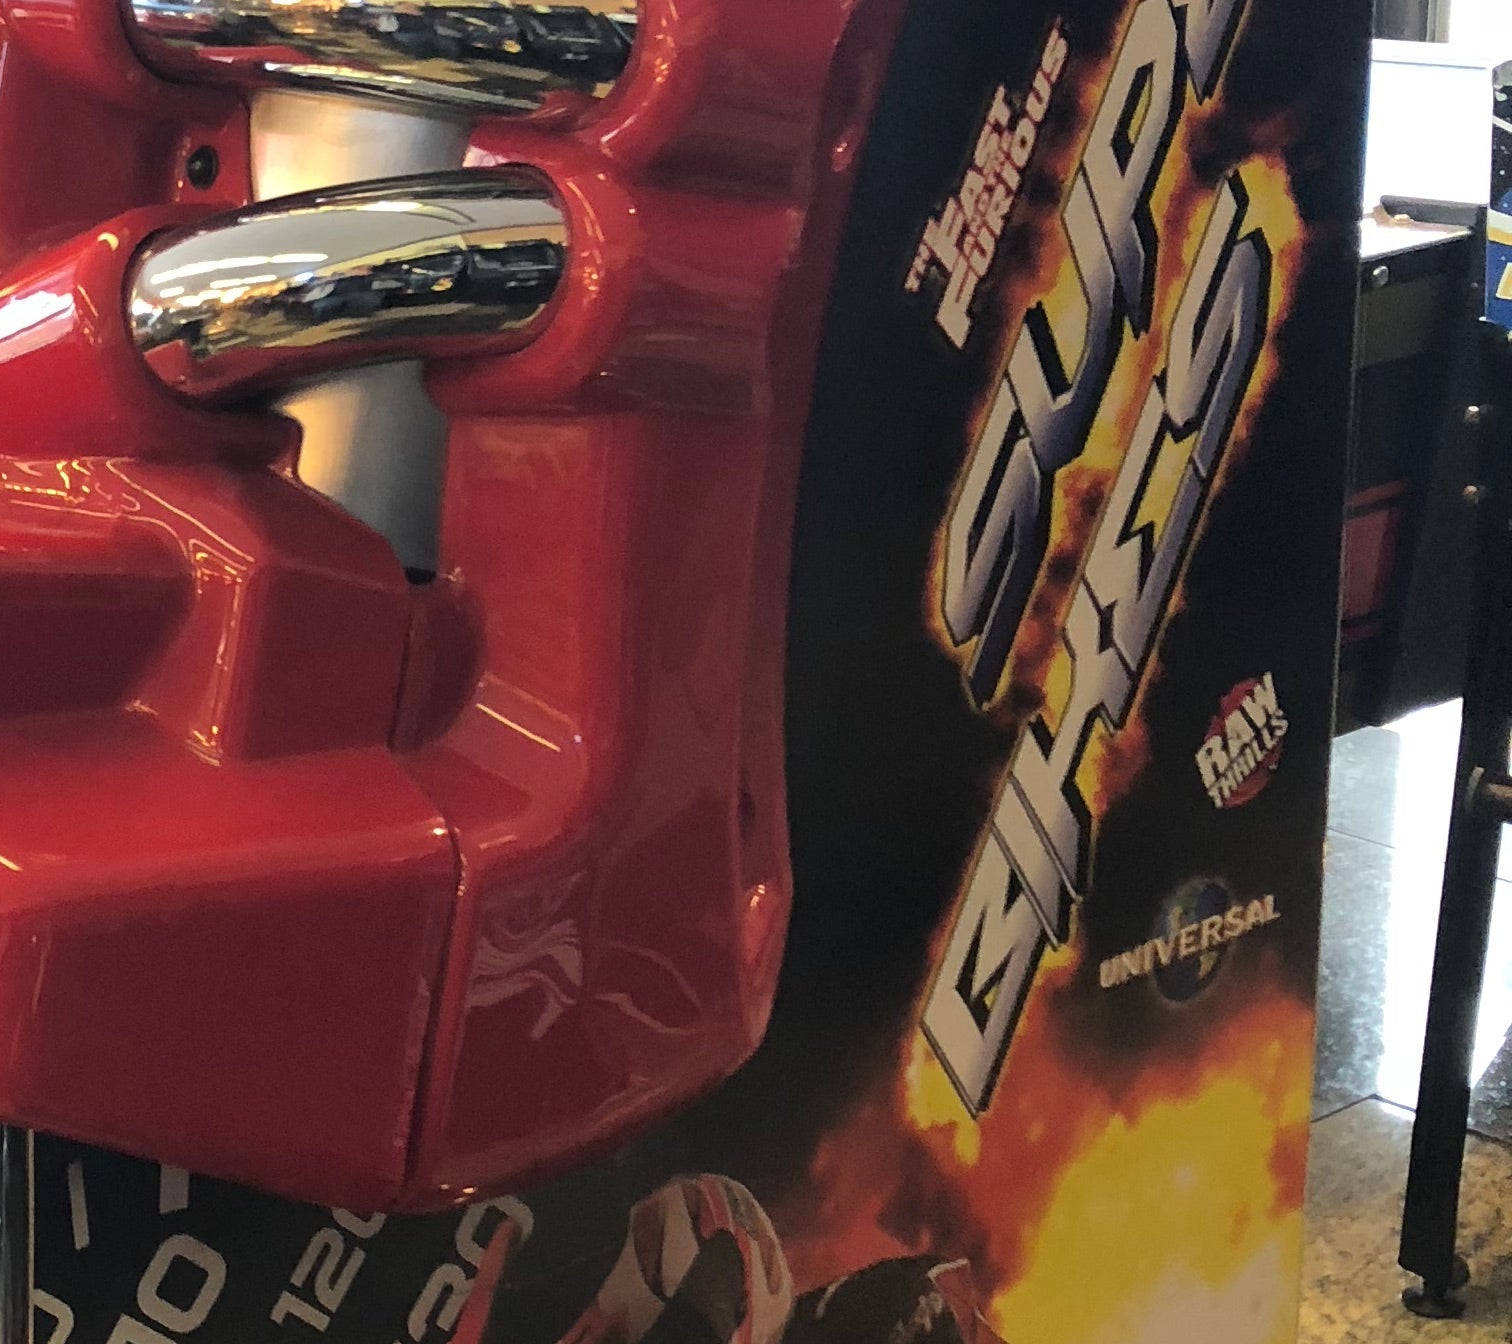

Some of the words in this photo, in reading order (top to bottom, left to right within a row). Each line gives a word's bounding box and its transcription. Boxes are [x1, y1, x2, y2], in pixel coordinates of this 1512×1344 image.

[925, 83, 1012, 274] FAST
[936, 24, 1068, 350] FURIOUS
[921, 170, 1273, 1120] BIKES
[1194, 671, 1278, 789] RAW
[1207, 709, 1289, 810] THRILLS
[1099, 894, 1281, 988] UNIVERSAL
